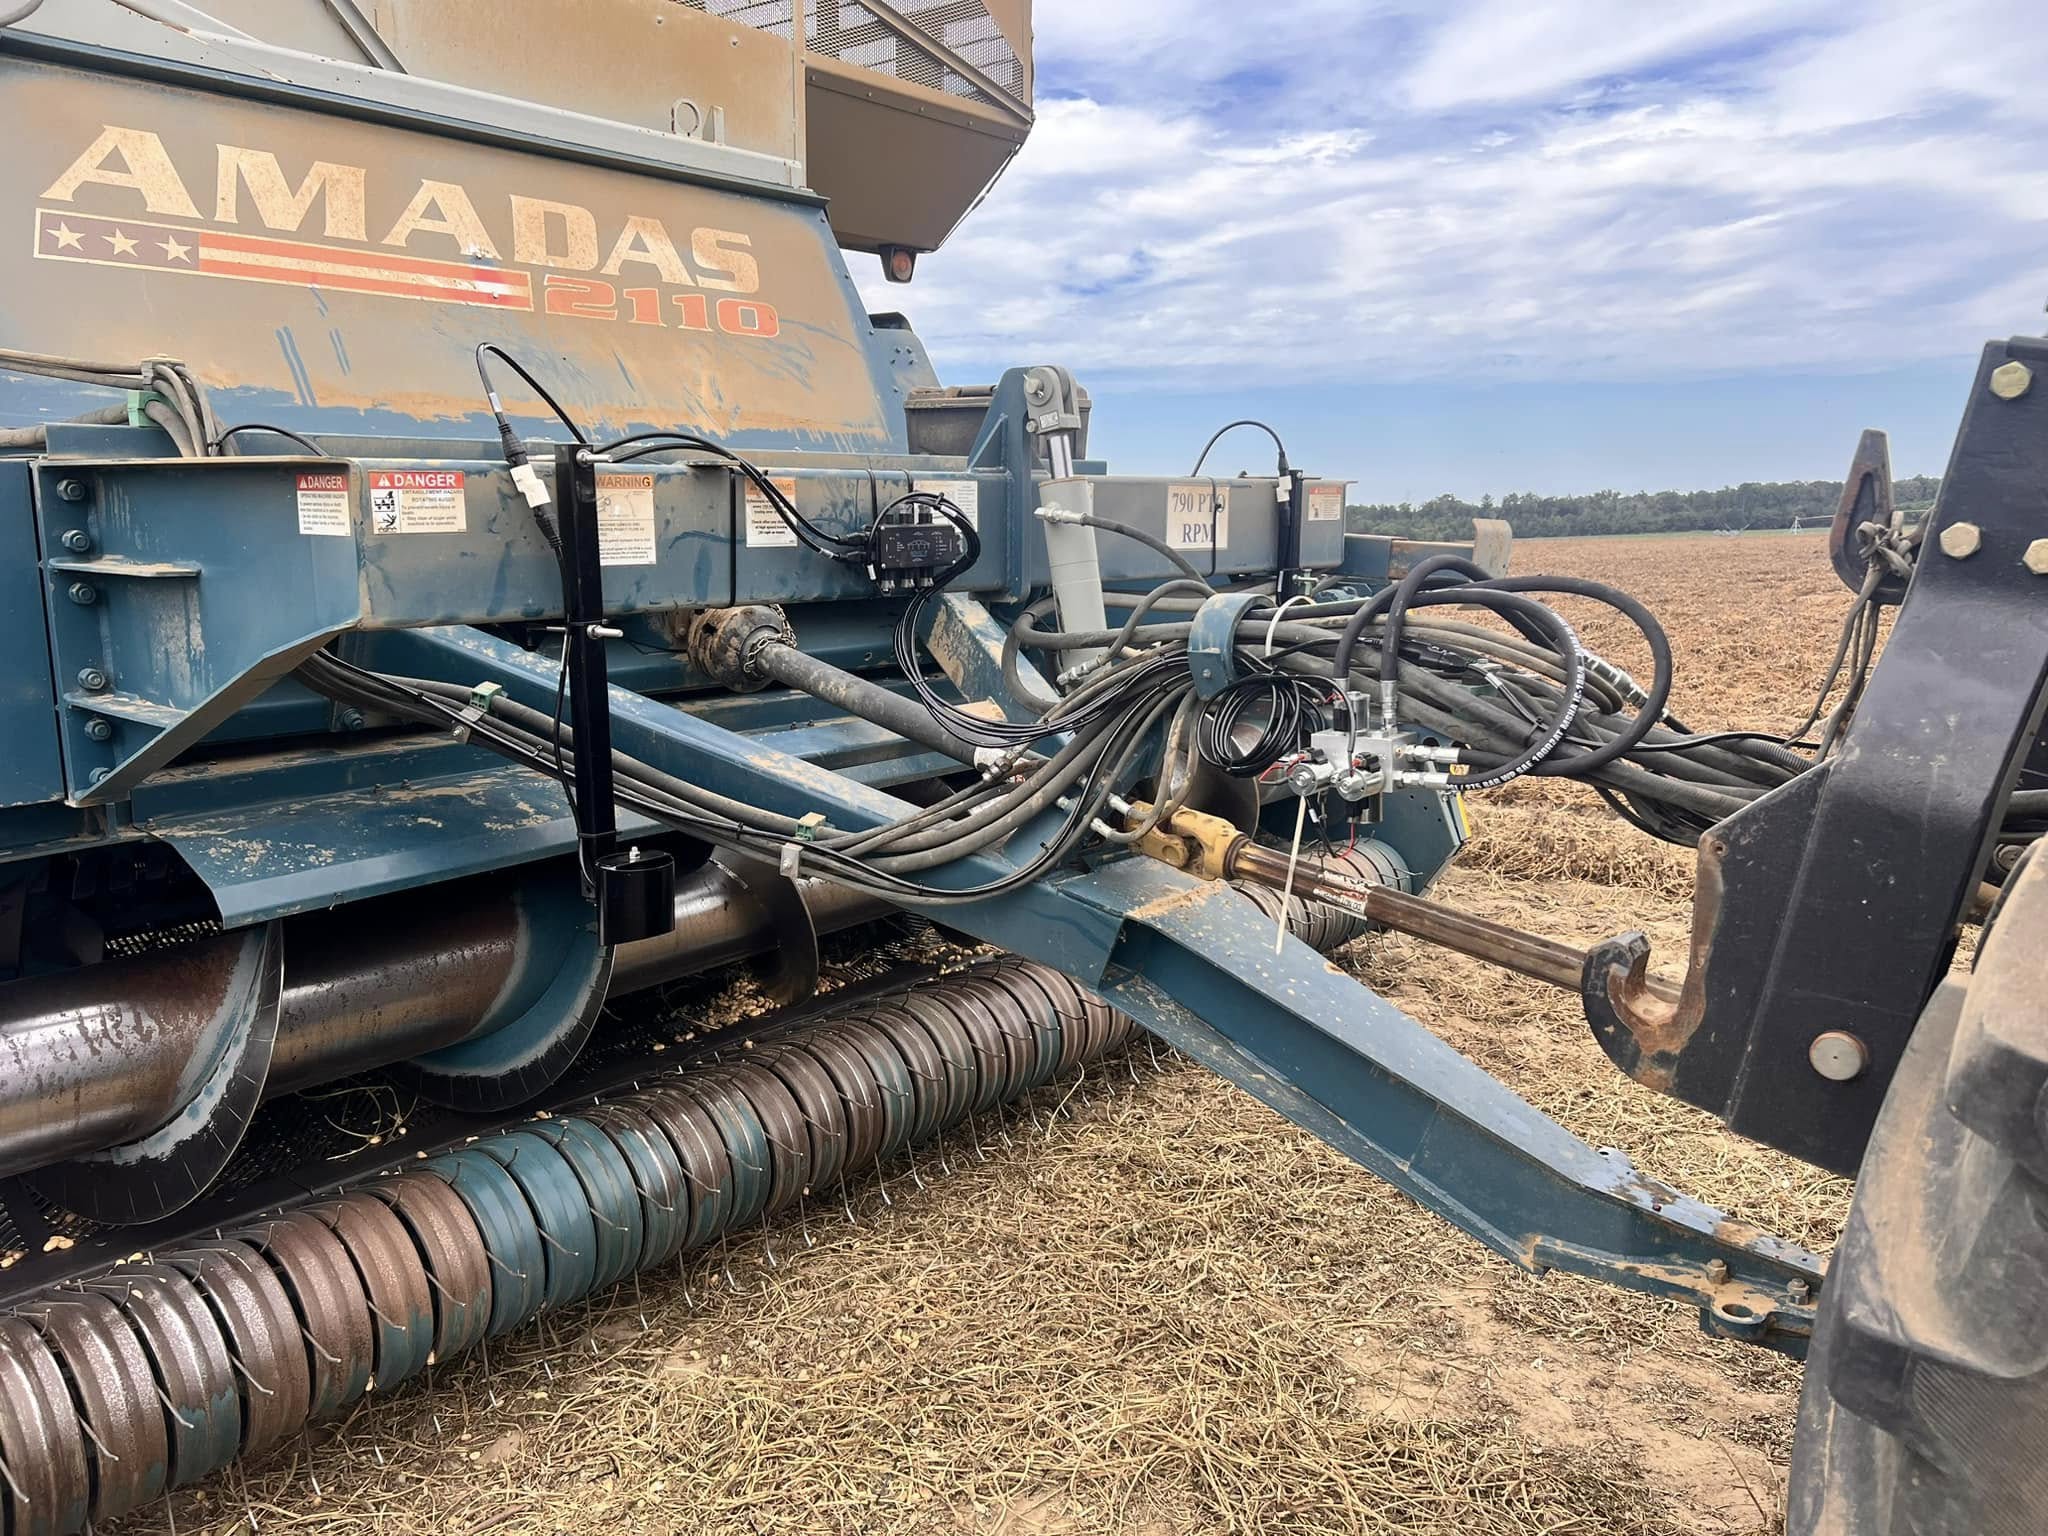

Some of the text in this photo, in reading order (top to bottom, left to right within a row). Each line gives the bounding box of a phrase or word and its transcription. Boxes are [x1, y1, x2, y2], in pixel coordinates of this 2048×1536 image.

[40, 125, 760, 293] AMADAS
[542, 274, 780, 338] 2110
[307, 475, 343, 489] DANGER
[394, 474, 457, 487] DANGER
[597, 476, 651, 487] WARNING
[1171, 493, 1226, 513] 790 PTO
[1182, 523, 1216, 543] RPM
[1516, 760, 1534, 773] SAE
